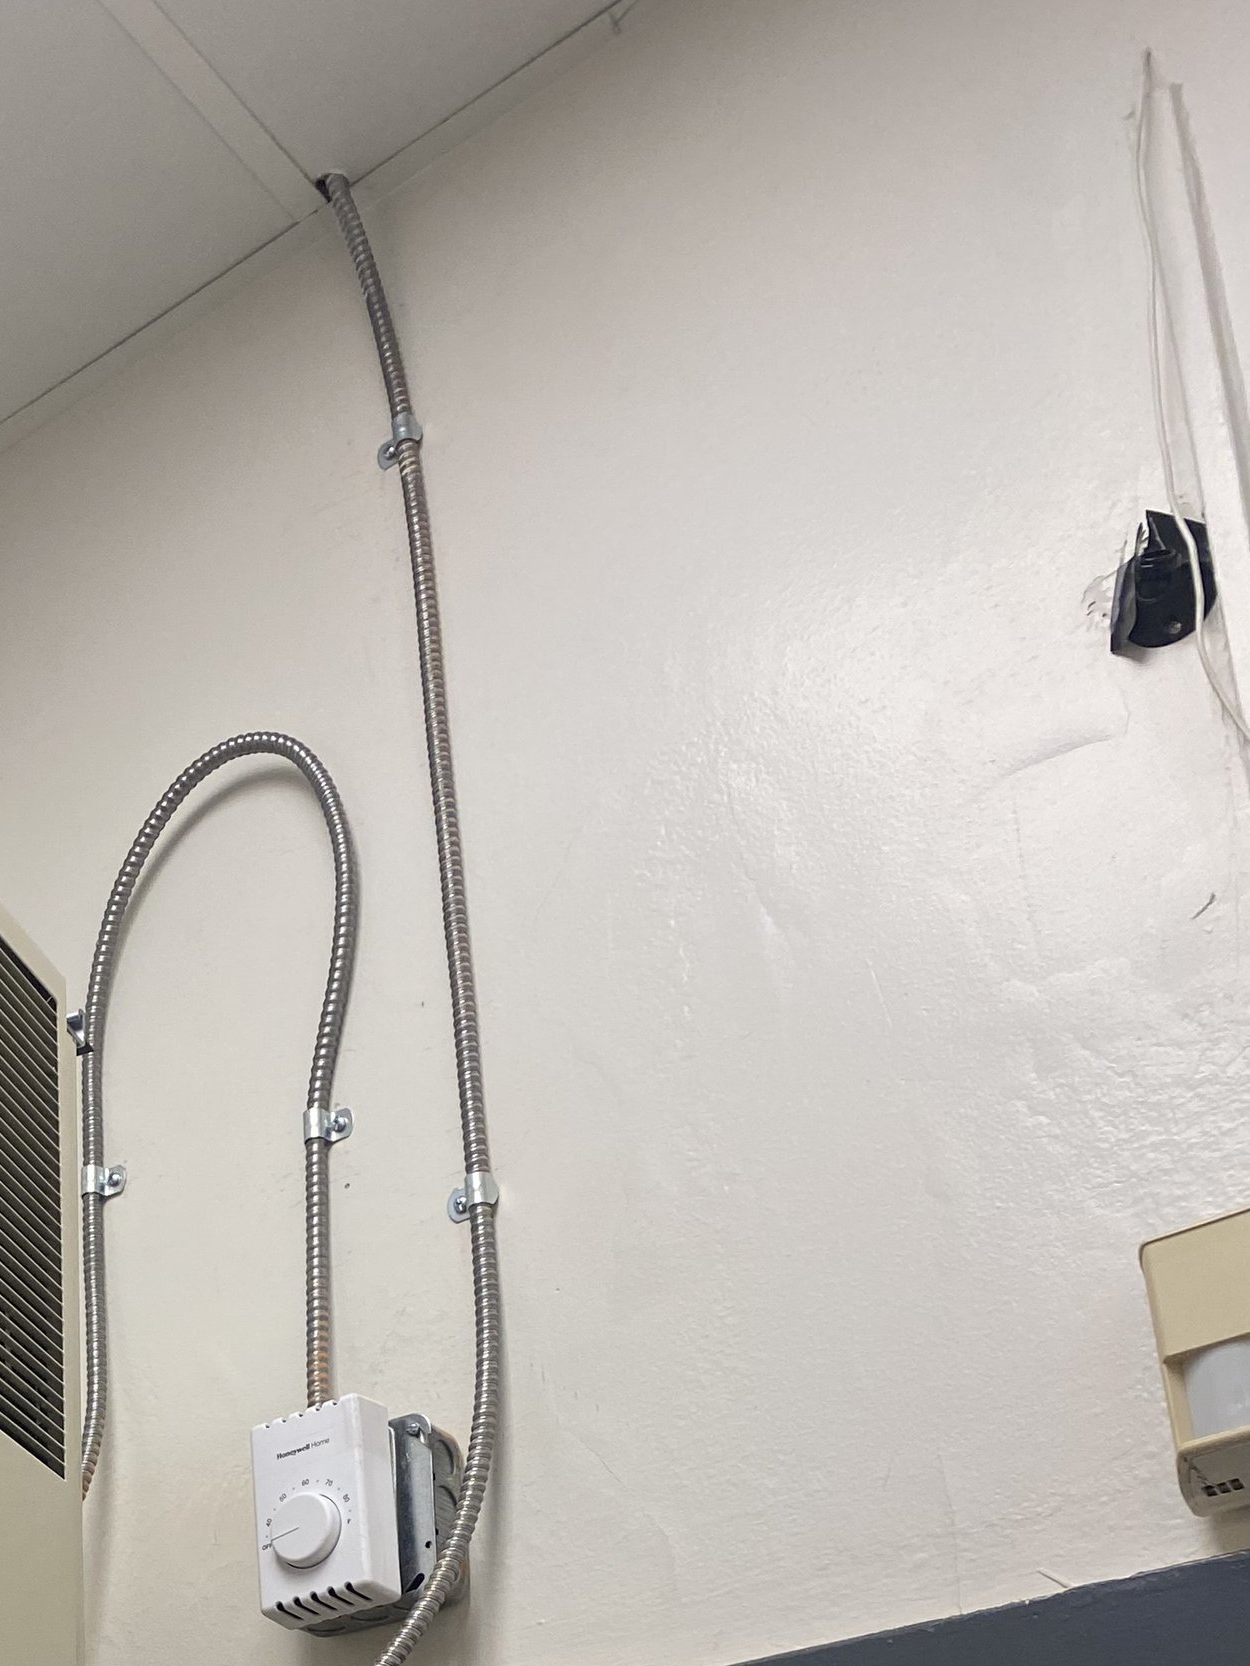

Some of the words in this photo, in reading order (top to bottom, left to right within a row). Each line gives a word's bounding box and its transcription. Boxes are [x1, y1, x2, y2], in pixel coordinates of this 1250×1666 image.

[276, 1443, 310, 1460] Honeywell
[311, 1438, 330, 1449] Home
[325, 1478, 334, 1487] 70
